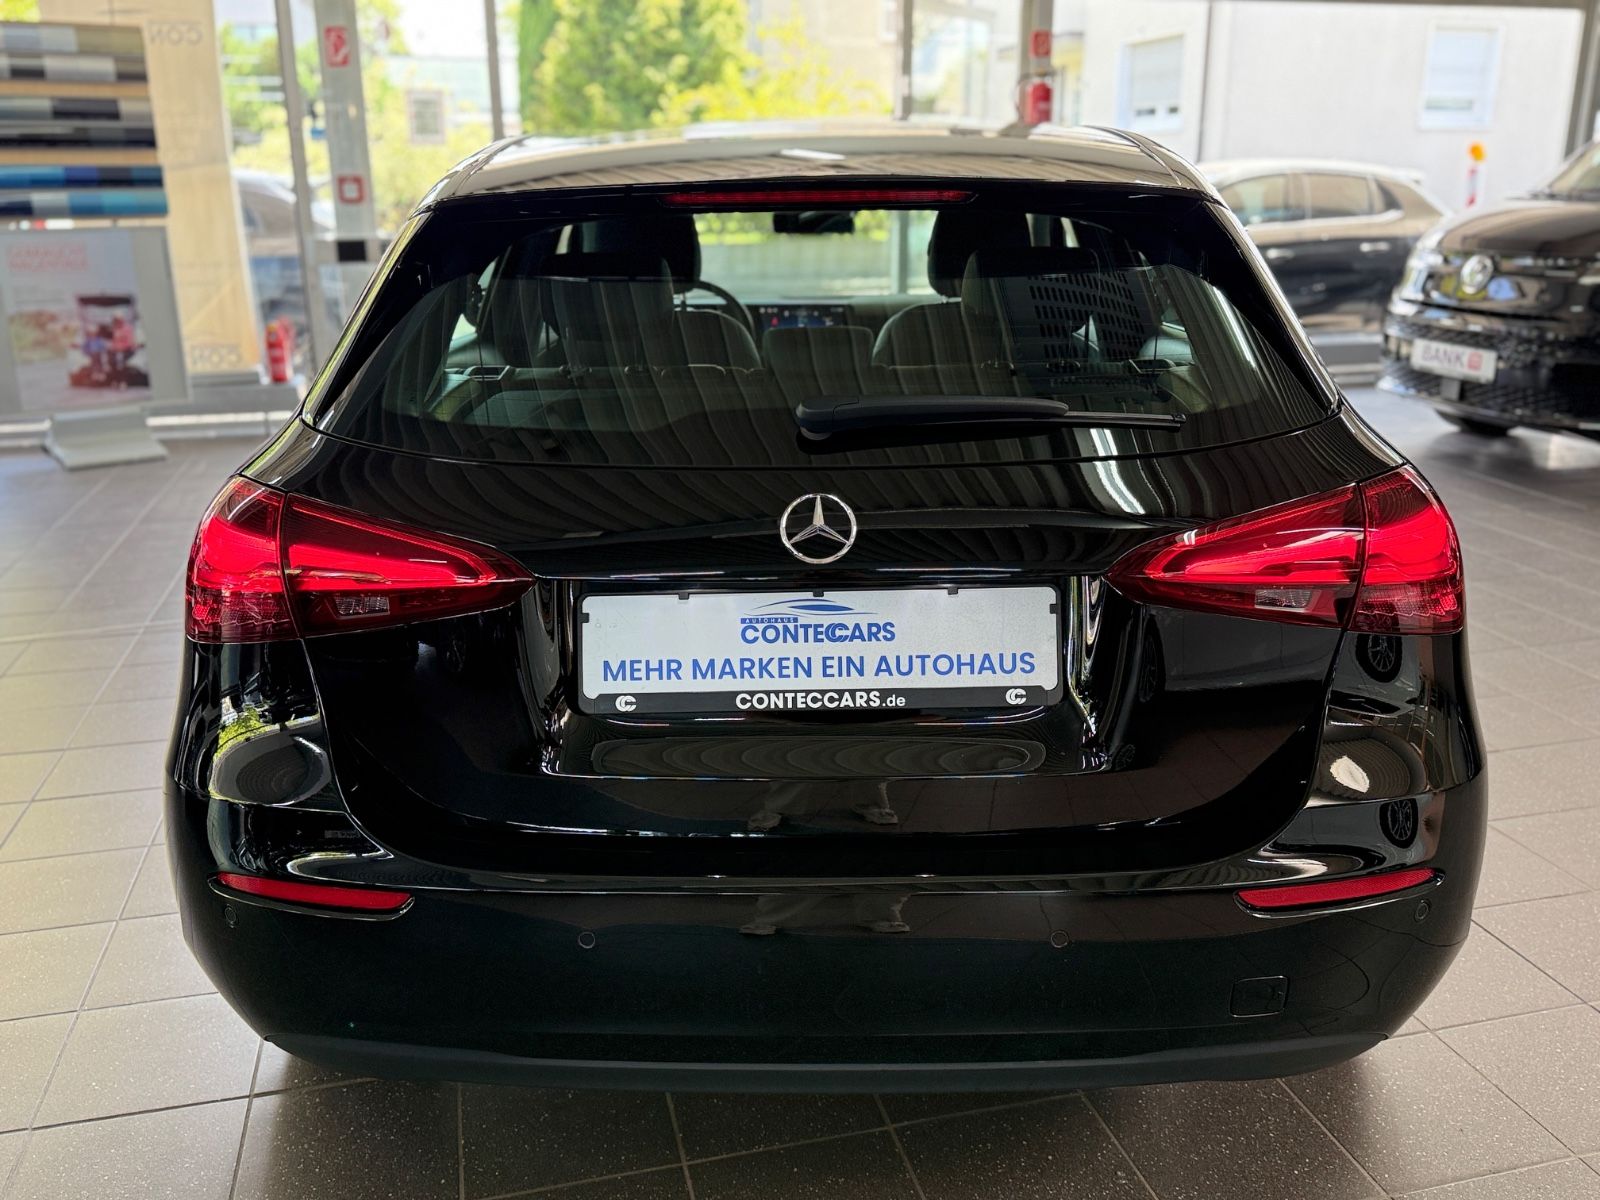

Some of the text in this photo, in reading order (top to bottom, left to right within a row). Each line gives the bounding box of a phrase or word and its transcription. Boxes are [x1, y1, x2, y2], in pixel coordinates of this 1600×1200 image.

[740, 622, 896, 644] CONTECCARS
[603, 652, 1036, 681] MEHR MARKEN EIN AUTOHAUS
[735, 691, 906, 710] CONTECCARS.de
